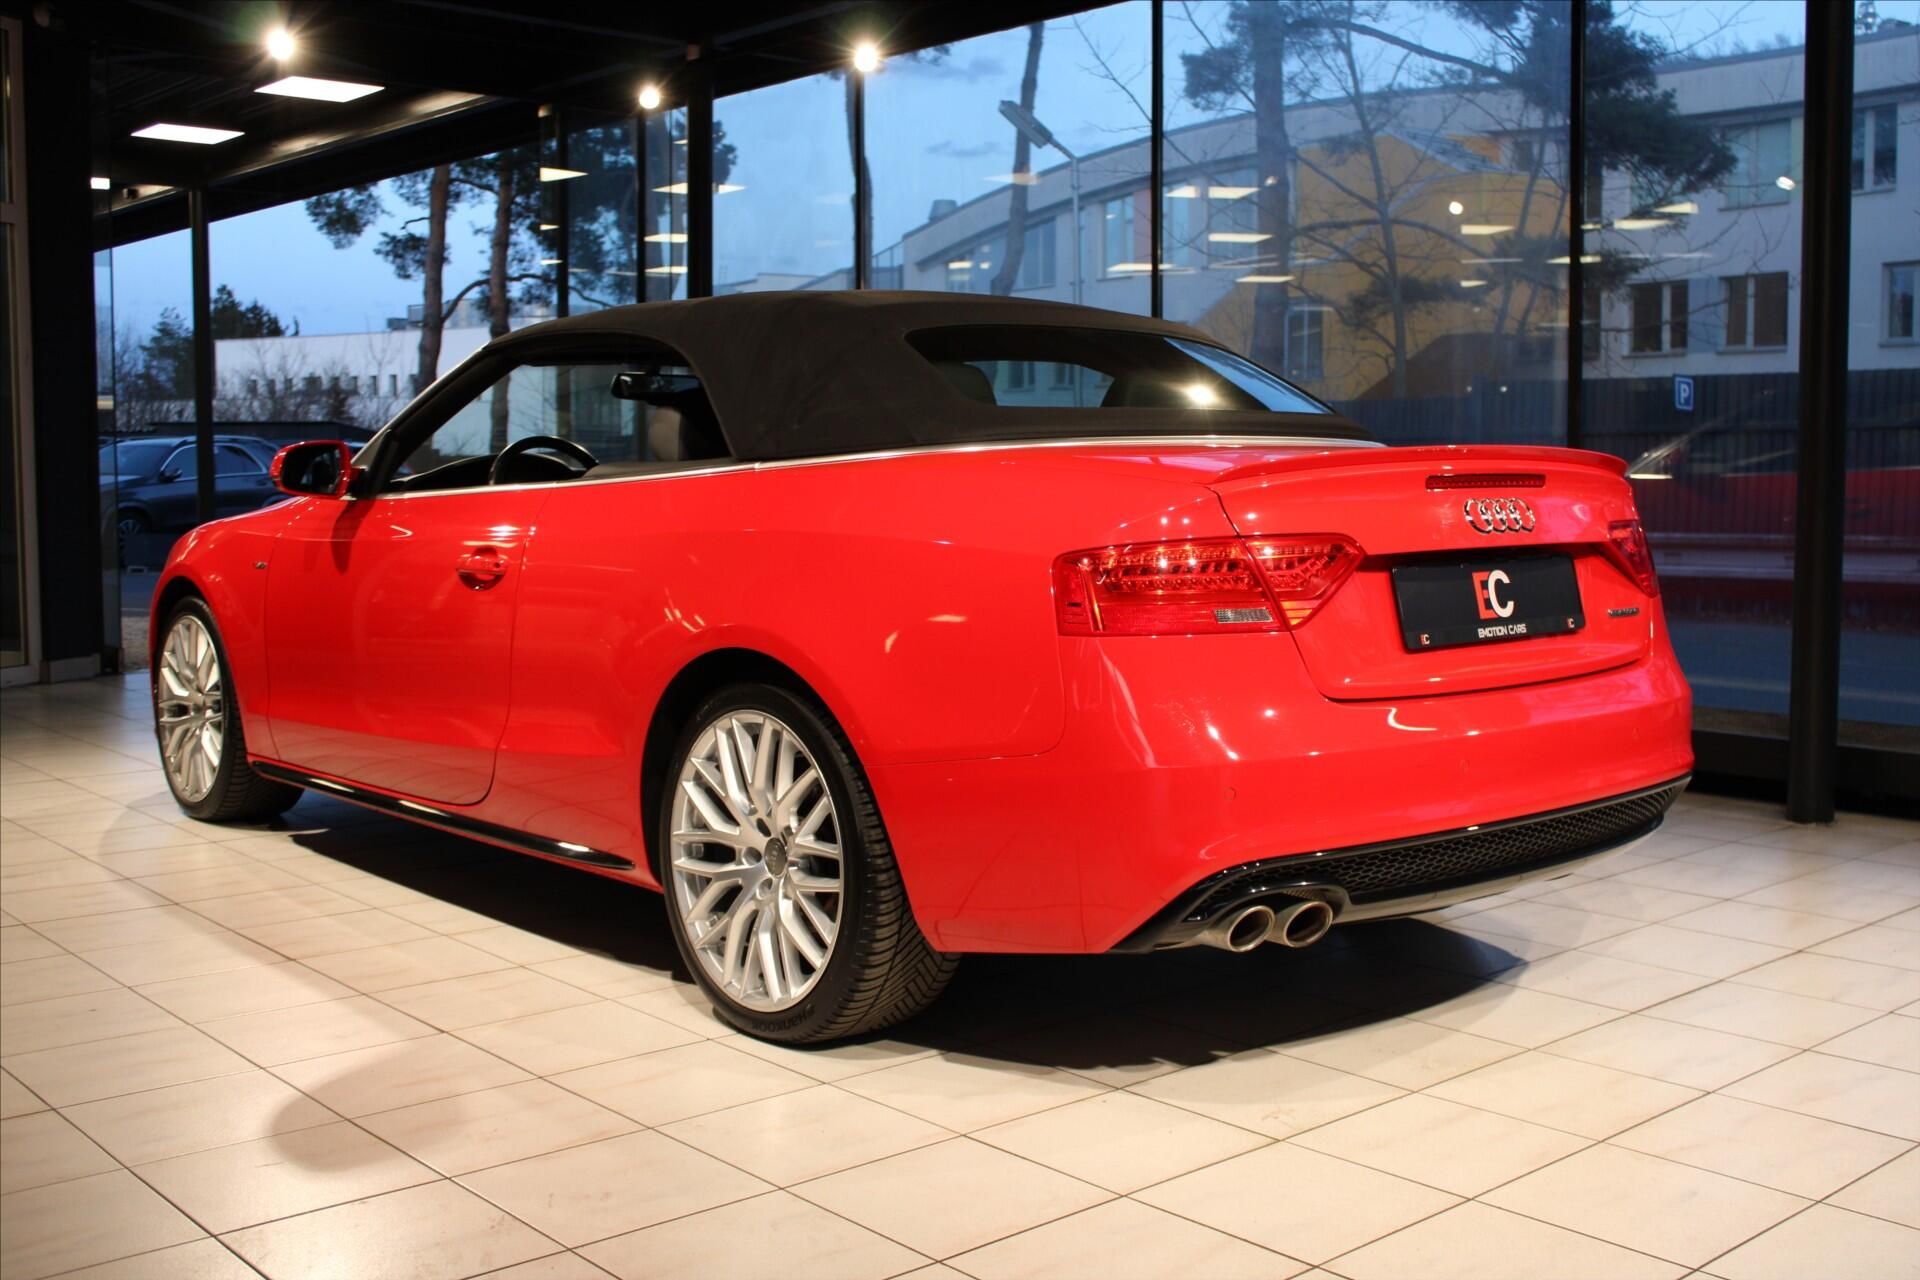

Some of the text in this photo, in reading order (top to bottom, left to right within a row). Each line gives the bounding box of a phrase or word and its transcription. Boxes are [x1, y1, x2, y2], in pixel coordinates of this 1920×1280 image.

[1680, 383, 1690, 404] P
[1472, 569, 1515, 619] EC
[1477, 623, 1527, 639] EMOTION CARS
